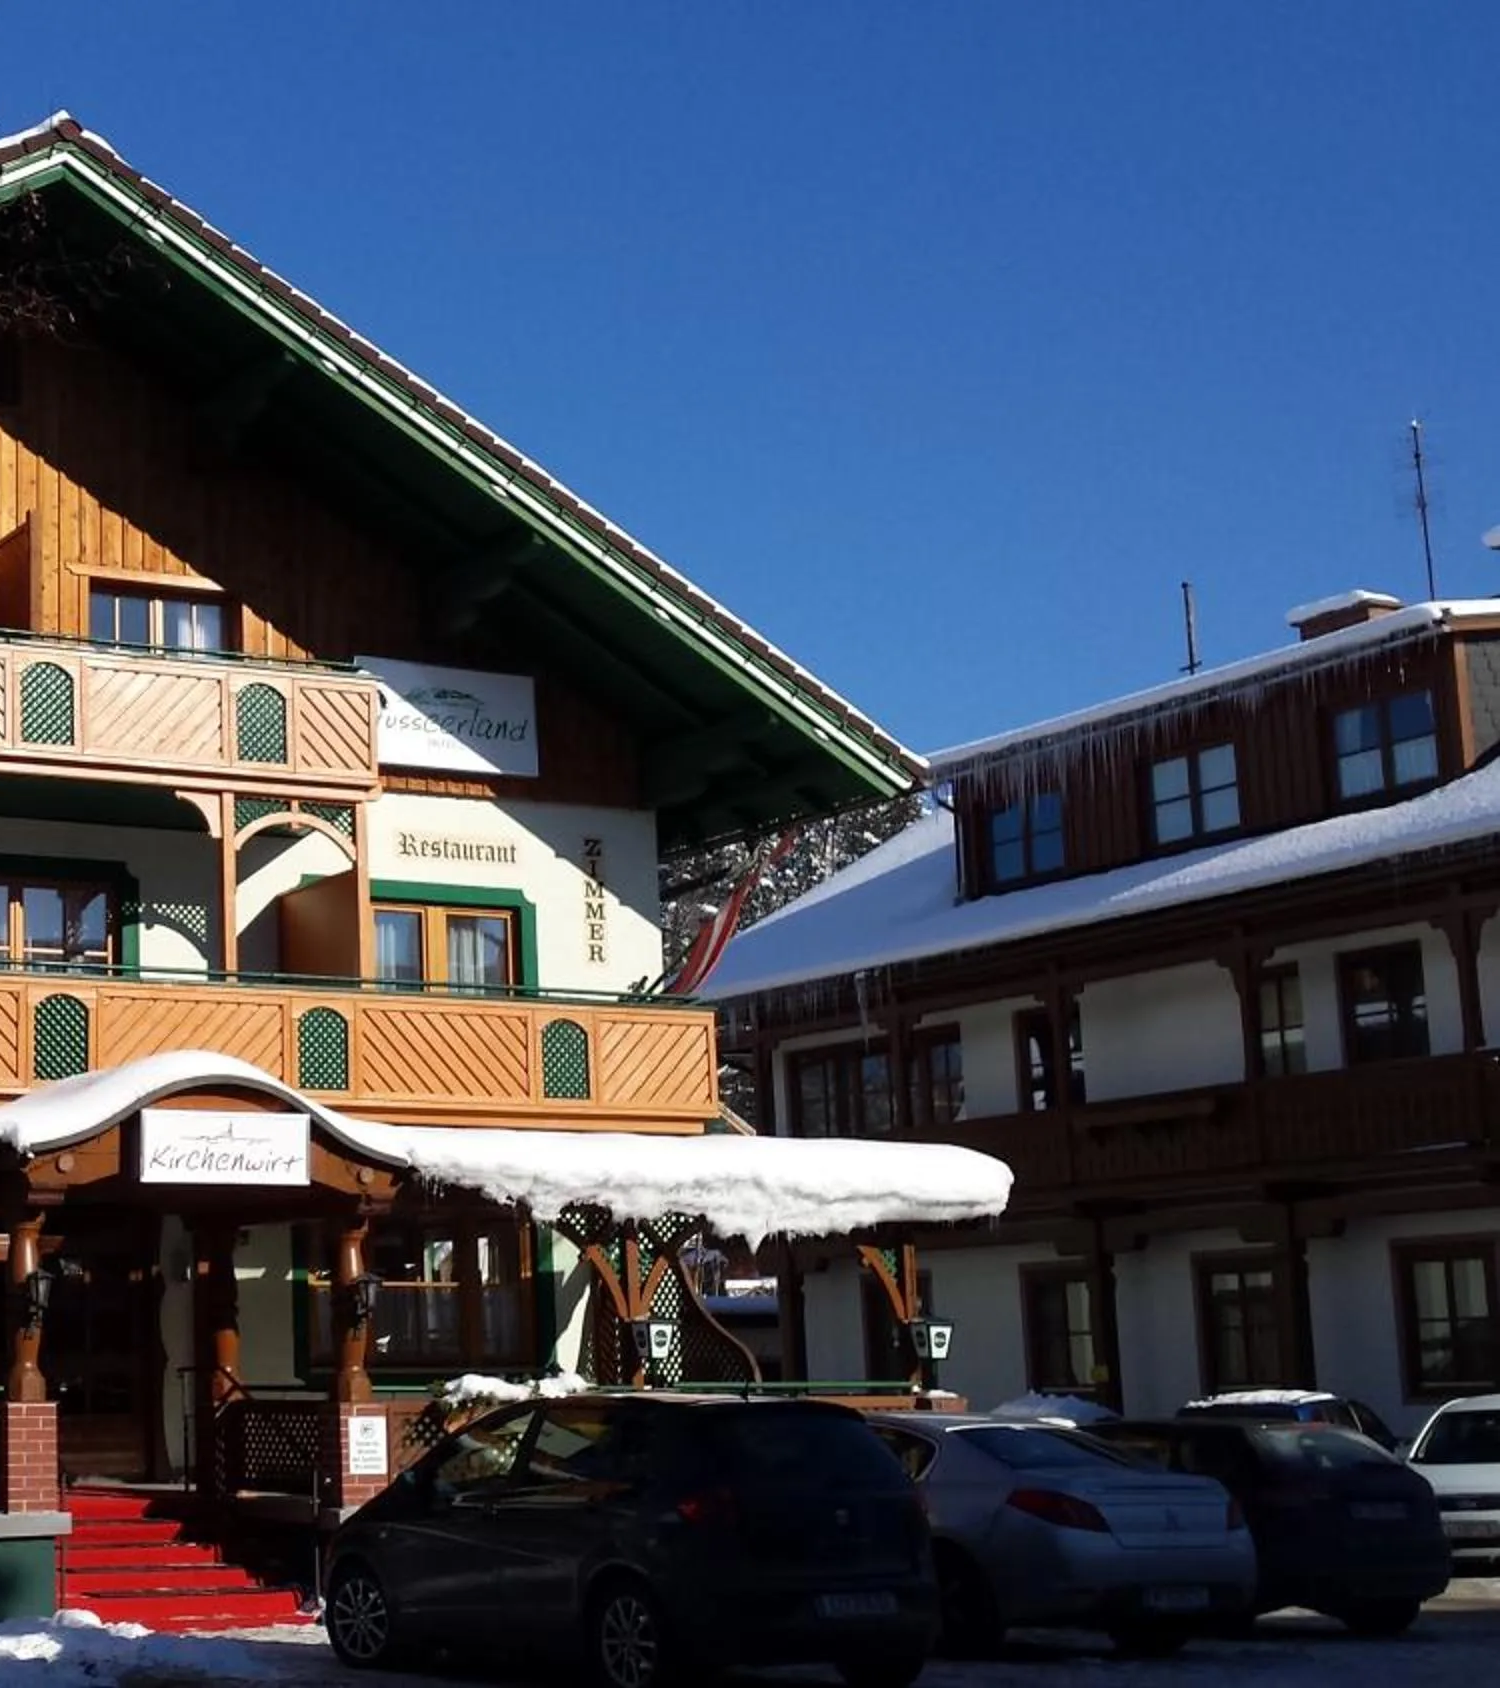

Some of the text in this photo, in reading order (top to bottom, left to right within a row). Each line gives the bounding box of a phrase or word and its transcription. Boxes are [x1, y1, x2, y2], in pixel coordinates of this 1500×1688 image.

[378, 706, 529, 742] usseerland
[398, 832, 517, 864] Restaurant
[583, 838, 606, 963] ZIMMER
[150, 1145, 304, 1173] Kirchenwirt
